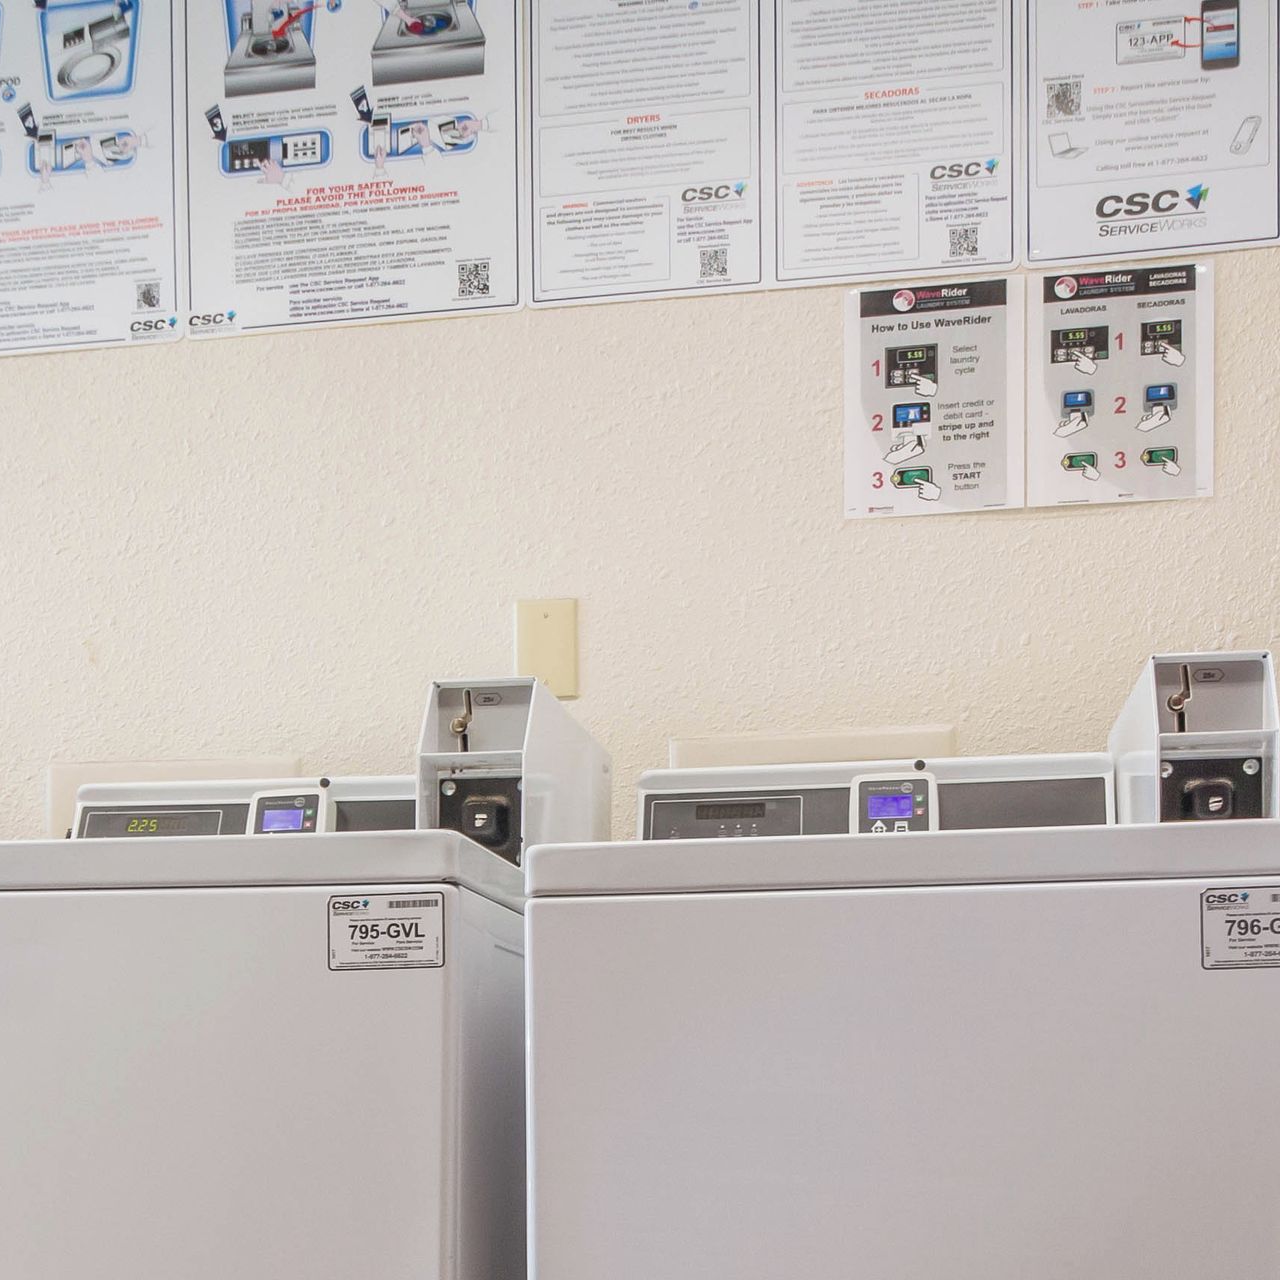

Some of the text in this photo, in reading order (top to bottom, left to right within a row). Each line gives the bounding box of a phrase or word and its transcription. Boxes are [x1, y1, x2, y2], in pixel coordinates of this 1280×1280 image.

[1128, 33, 1174, 48] 123-APP
[864, 86, 920, 100] SECADORAS
[626, 114, 661, 125] DRYERS
[930, 162, 981, 180] CSC
[306, 181, 394, 195] FOR YOUR SAFETY
[681, 185, 731, 202] CSC
[276, 185, 426, 206] PLEASE AVOID THE FOLLOWING
[1095, 190, 1180, 219] CSC
[1078, 273, 1133, 285] WaveRider
[916, 288, 968, 300] WaveRider
[1060, 305, 1107, 315] LAVADORAS
[1137, 299, 1186, 309] SECADORAS
[130, 319, 166, 332] CSC
[188, 313, 225, 327] CSC
[871, 314, 992, 334] How to Use WaveRider
[1114, 332, 1124, 350] 1
[952, 344, 978, 353] Select
[950, 354, 980, 366] laundry
[872, 359, 881, 377] 1
[954, 366, 976, 376] cycle
[937, 402, 960, 410] Insert
[961, 400, 985, 408] credit
[1114, 396, 1127, 414] 2
[943, 410, 984, 421] debit card
[872, 414, 884, 432] 2
[937, 420, 995, 432] stripe up and
[942, 430, 990, 442] to the right
[947, 460, 986, 470] Press the
[1114, 451, 1126, 469] 3
[872, 472, 884, 489] 3
[952, 471, 982, 481] START
[954, 482, 980, 491] button
[332, 900, 361, 910] CSC
[1206, 894, 1239, 904] CSC
[348, 922, 425, 940] 795-GVL
